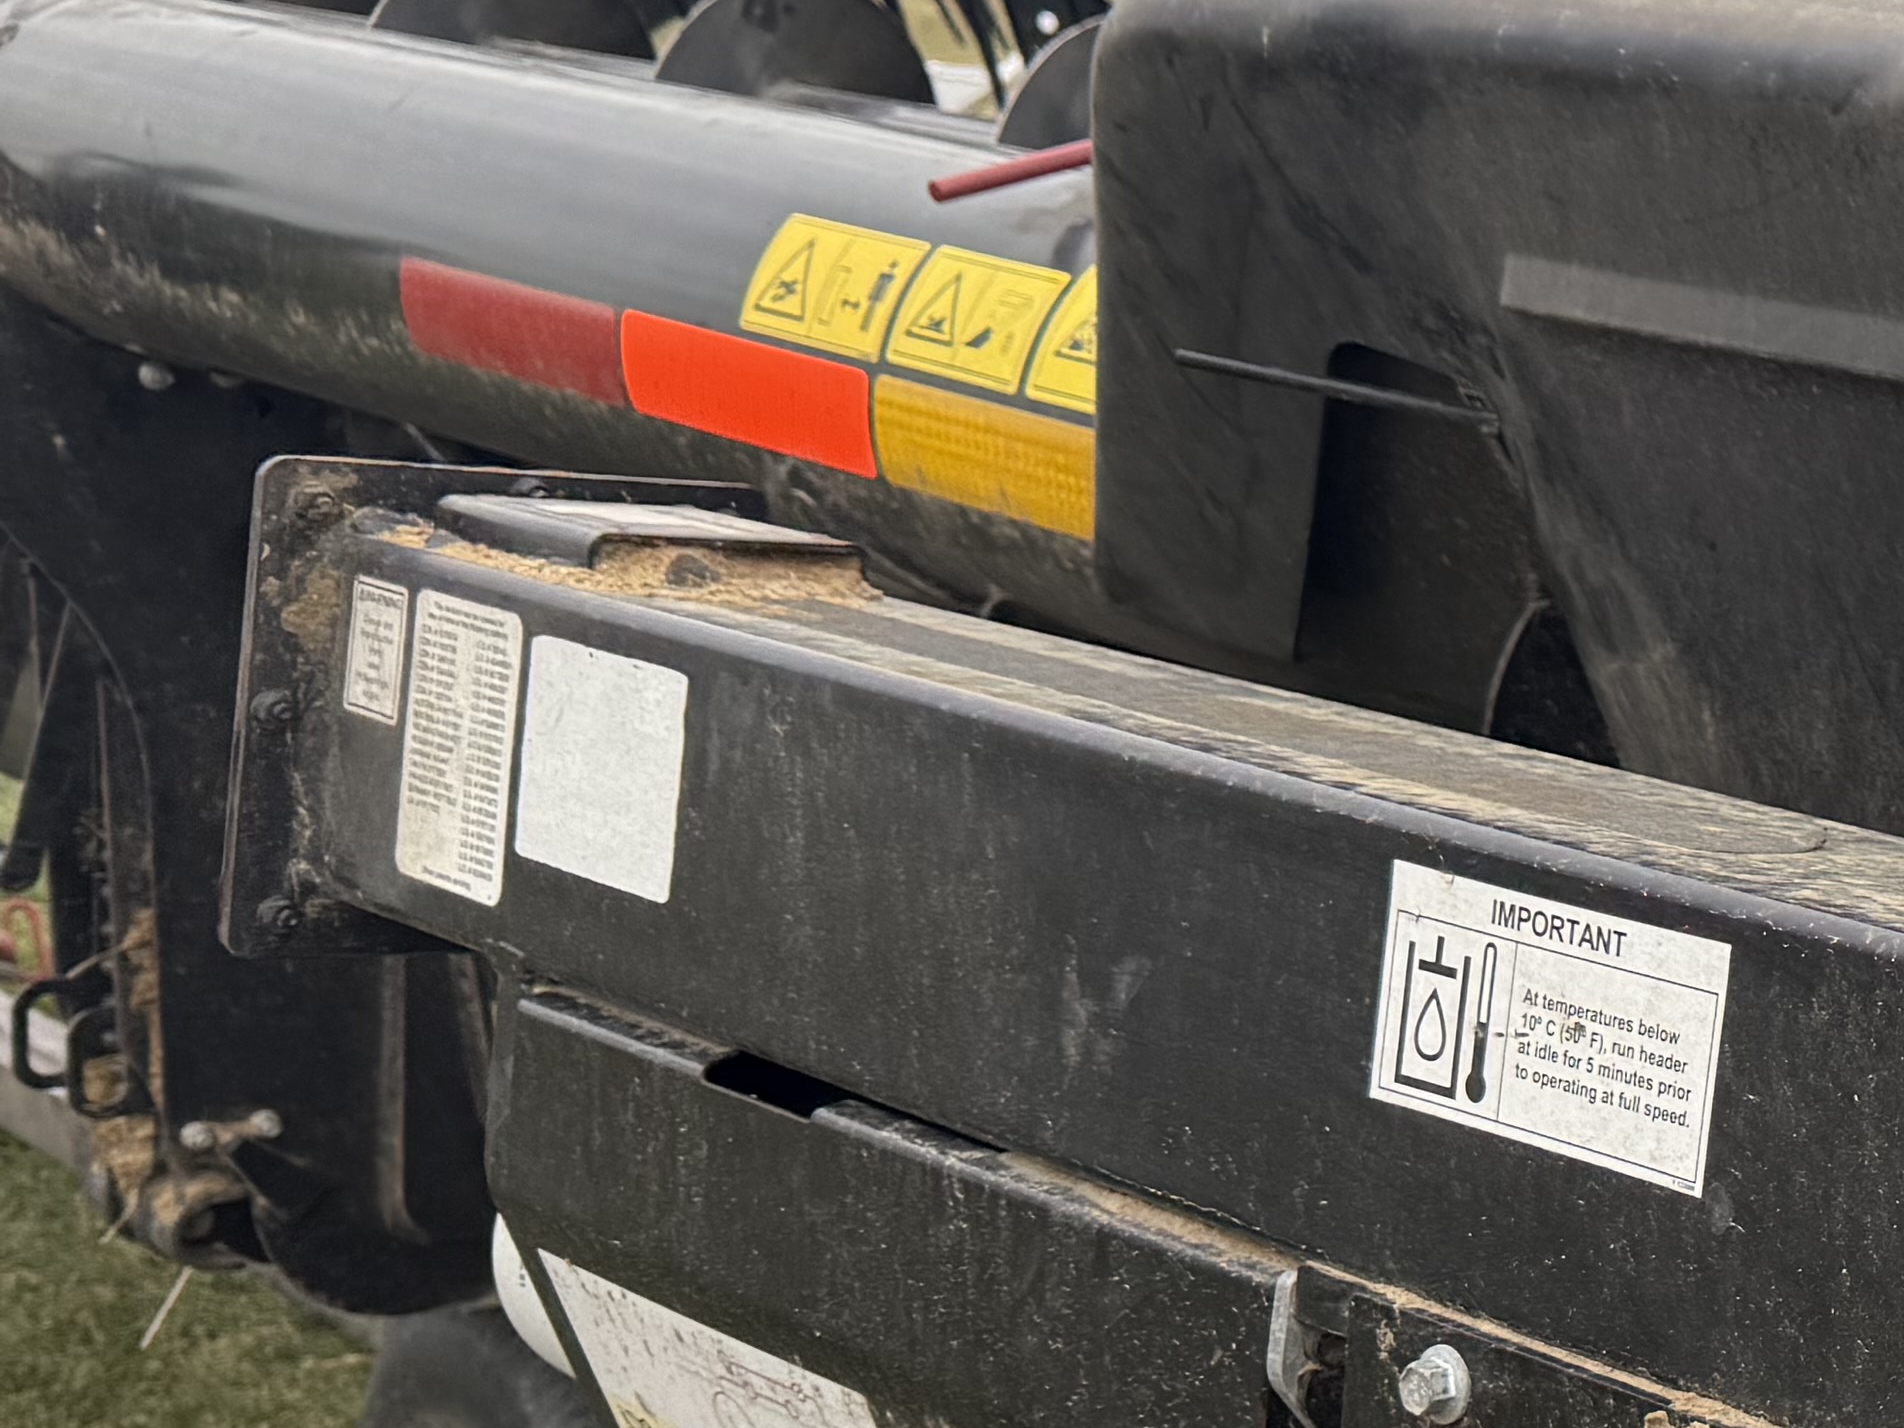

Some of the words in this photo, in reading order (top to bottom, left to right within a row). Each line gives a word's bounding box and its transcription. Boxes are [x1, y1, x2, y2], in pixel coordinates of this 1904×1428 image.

[1490, 898, 1628, 958] IMPORTANT
[1522, 988, 1539, 1007] At
[1542, 992, 1634, 1034] temperatures
[1637, 1021, 1681, 1046] below
[1546, 1019, 1556, 1038] C
[1611, 1041, 1636, 1060] run
[1638, 1045, 1689, 1075] header
[1515, 1063, 1529, 1081] to
[1532, 1068, 1597, 1105] operating
[1600, 1087, 1615, 1105] at
[1618, 1092, 1640, 1114] full
[1643, 1100, 1690, 1129] speed.
[1517, 1040, 1532, 1056] at
[1534, 1041, 1559, 1063] idle
[1562, 1049, 1582, 1070] for
[1586, 1056, 1595, 1073] 5
[1598, 1060, 1654, 1092] minutes
[1657, 1078, 1692, 1105] prior
